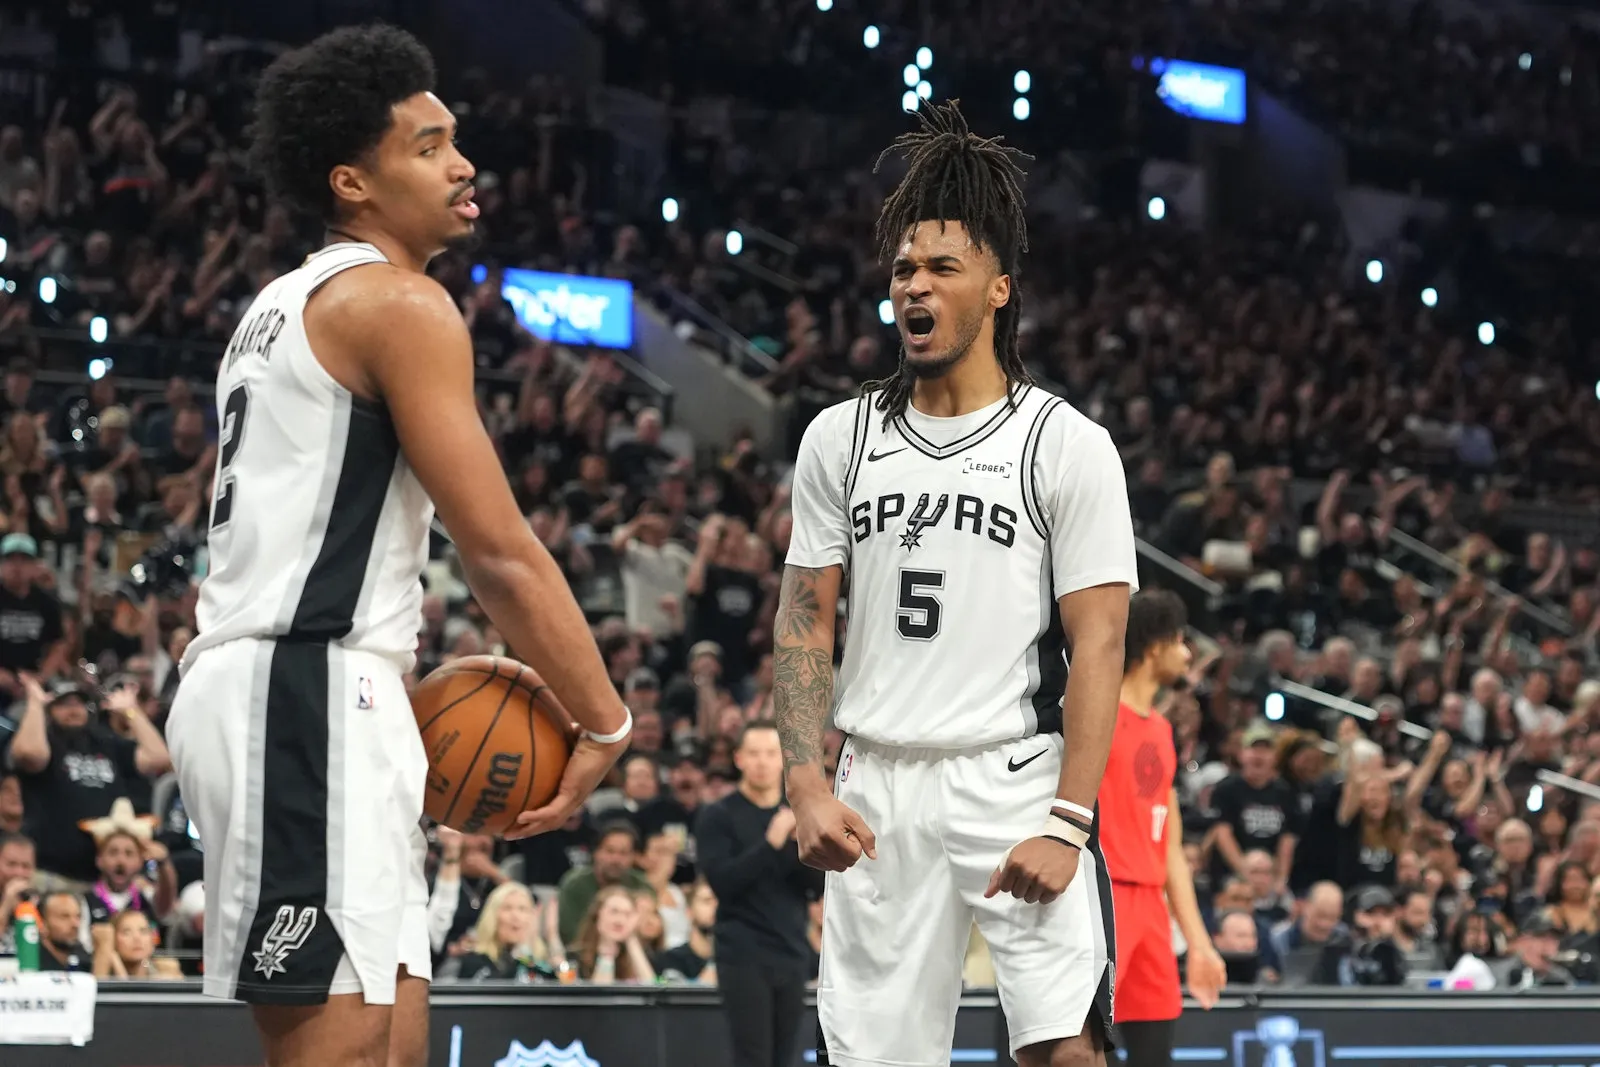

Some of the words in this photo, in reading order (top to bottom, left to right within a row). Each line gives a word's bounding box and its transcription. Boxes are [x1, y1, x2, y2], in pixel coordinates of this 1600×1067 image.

[210, 380, 251, 532] 2
[969, 462, 1006, 473] LEDGER
[852, 493, 1018, 552] SPURS
[896, 567, 946, 642] 5
